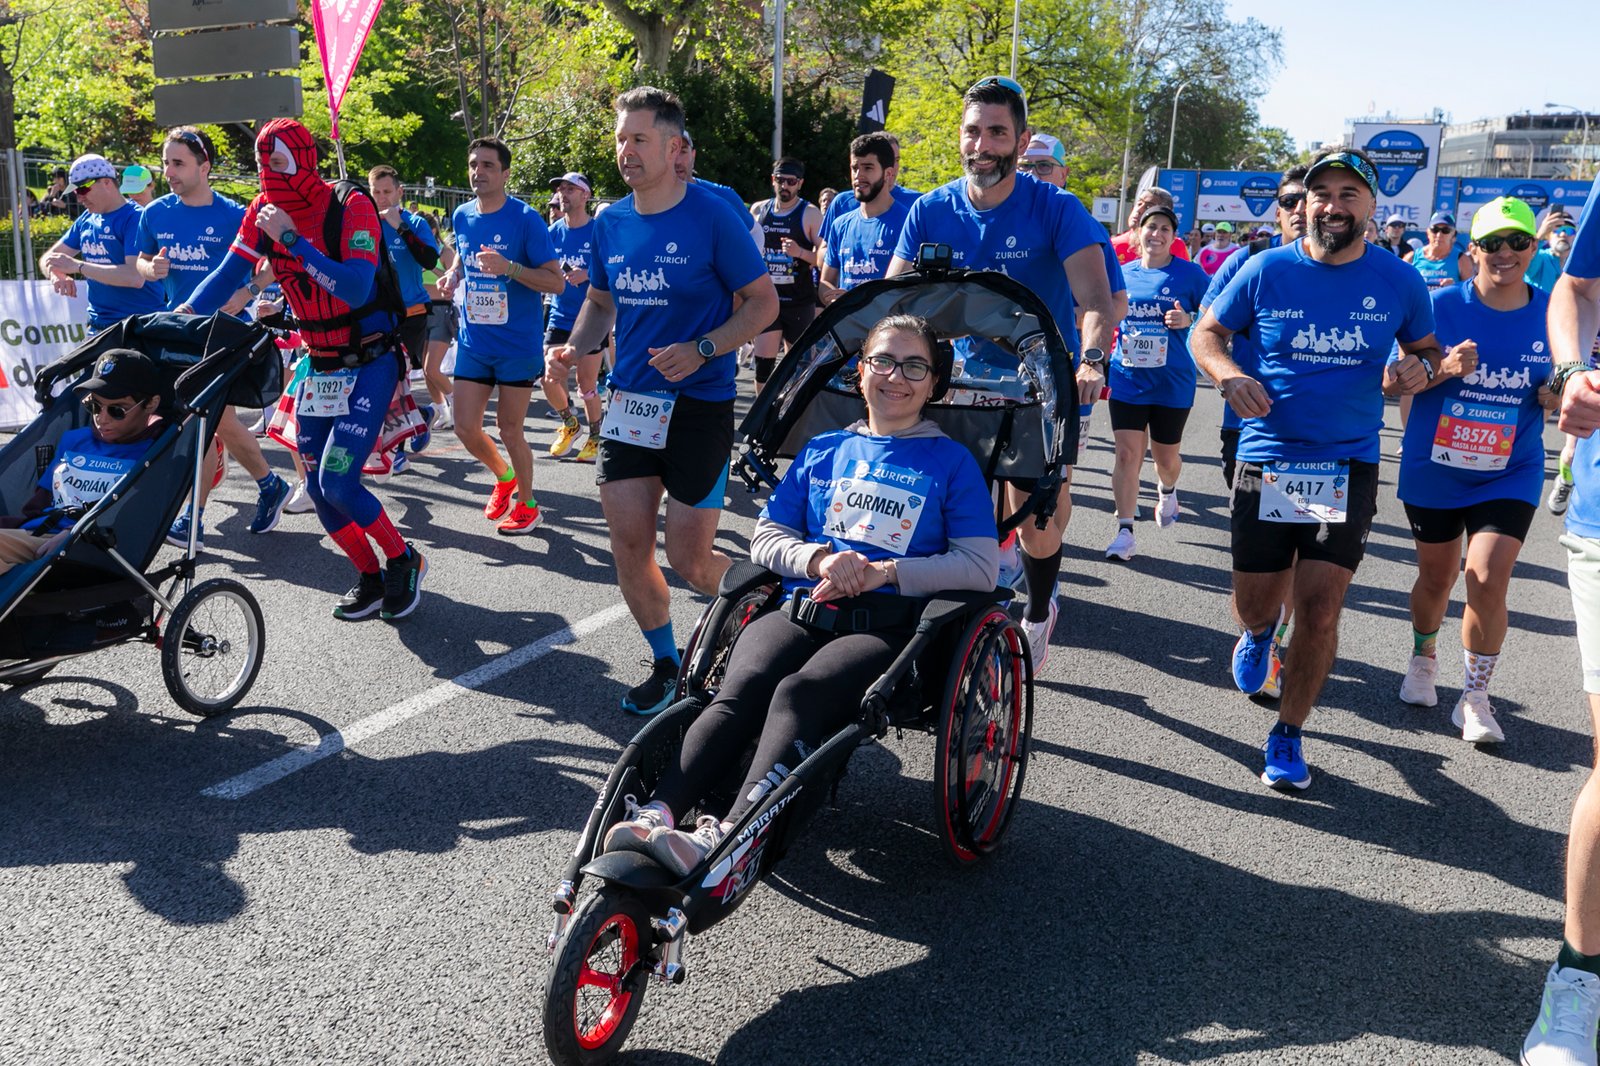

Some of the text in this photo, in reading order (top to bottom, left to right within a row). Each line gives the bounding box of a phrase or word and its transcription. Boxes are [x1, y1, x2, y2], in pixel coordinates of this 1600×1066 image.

[1401, 151, 1424, 159] Roll
[654, 255, 687, 264] ZURICH
[995, 250, 1028, 260] ZURICH
[475, 296, 495, 306] 3356
[1271, 309, 1304, 319] aefat
[1349, 312, 1387, 321] ZURICH
[0, 319, 85, 346] Comu
[1133, 339, 1153, 349] 7801
[1520, 354, 1551, 363] ZURICH
[317, 381, 342, 393] 12921
[624, 399, 659, 418] 12639
[1468, 408, 1506, 420] ZURICH
[338, 421, 368, 436] aefat
[1452, 425, 1497, 445] 58576
[1451, 441, 1469, 449] HASTA
[88, 460, 123, 471] ZURICH
[1294, 462, 1335, 471] ZURICH
[873, 468, 916, 487] ZURICH
[64, 475, 110, 494] ADRIÁN
[1285, 480, 1325, 495] 6417
[846, 492, 906, 519] CARMEN
